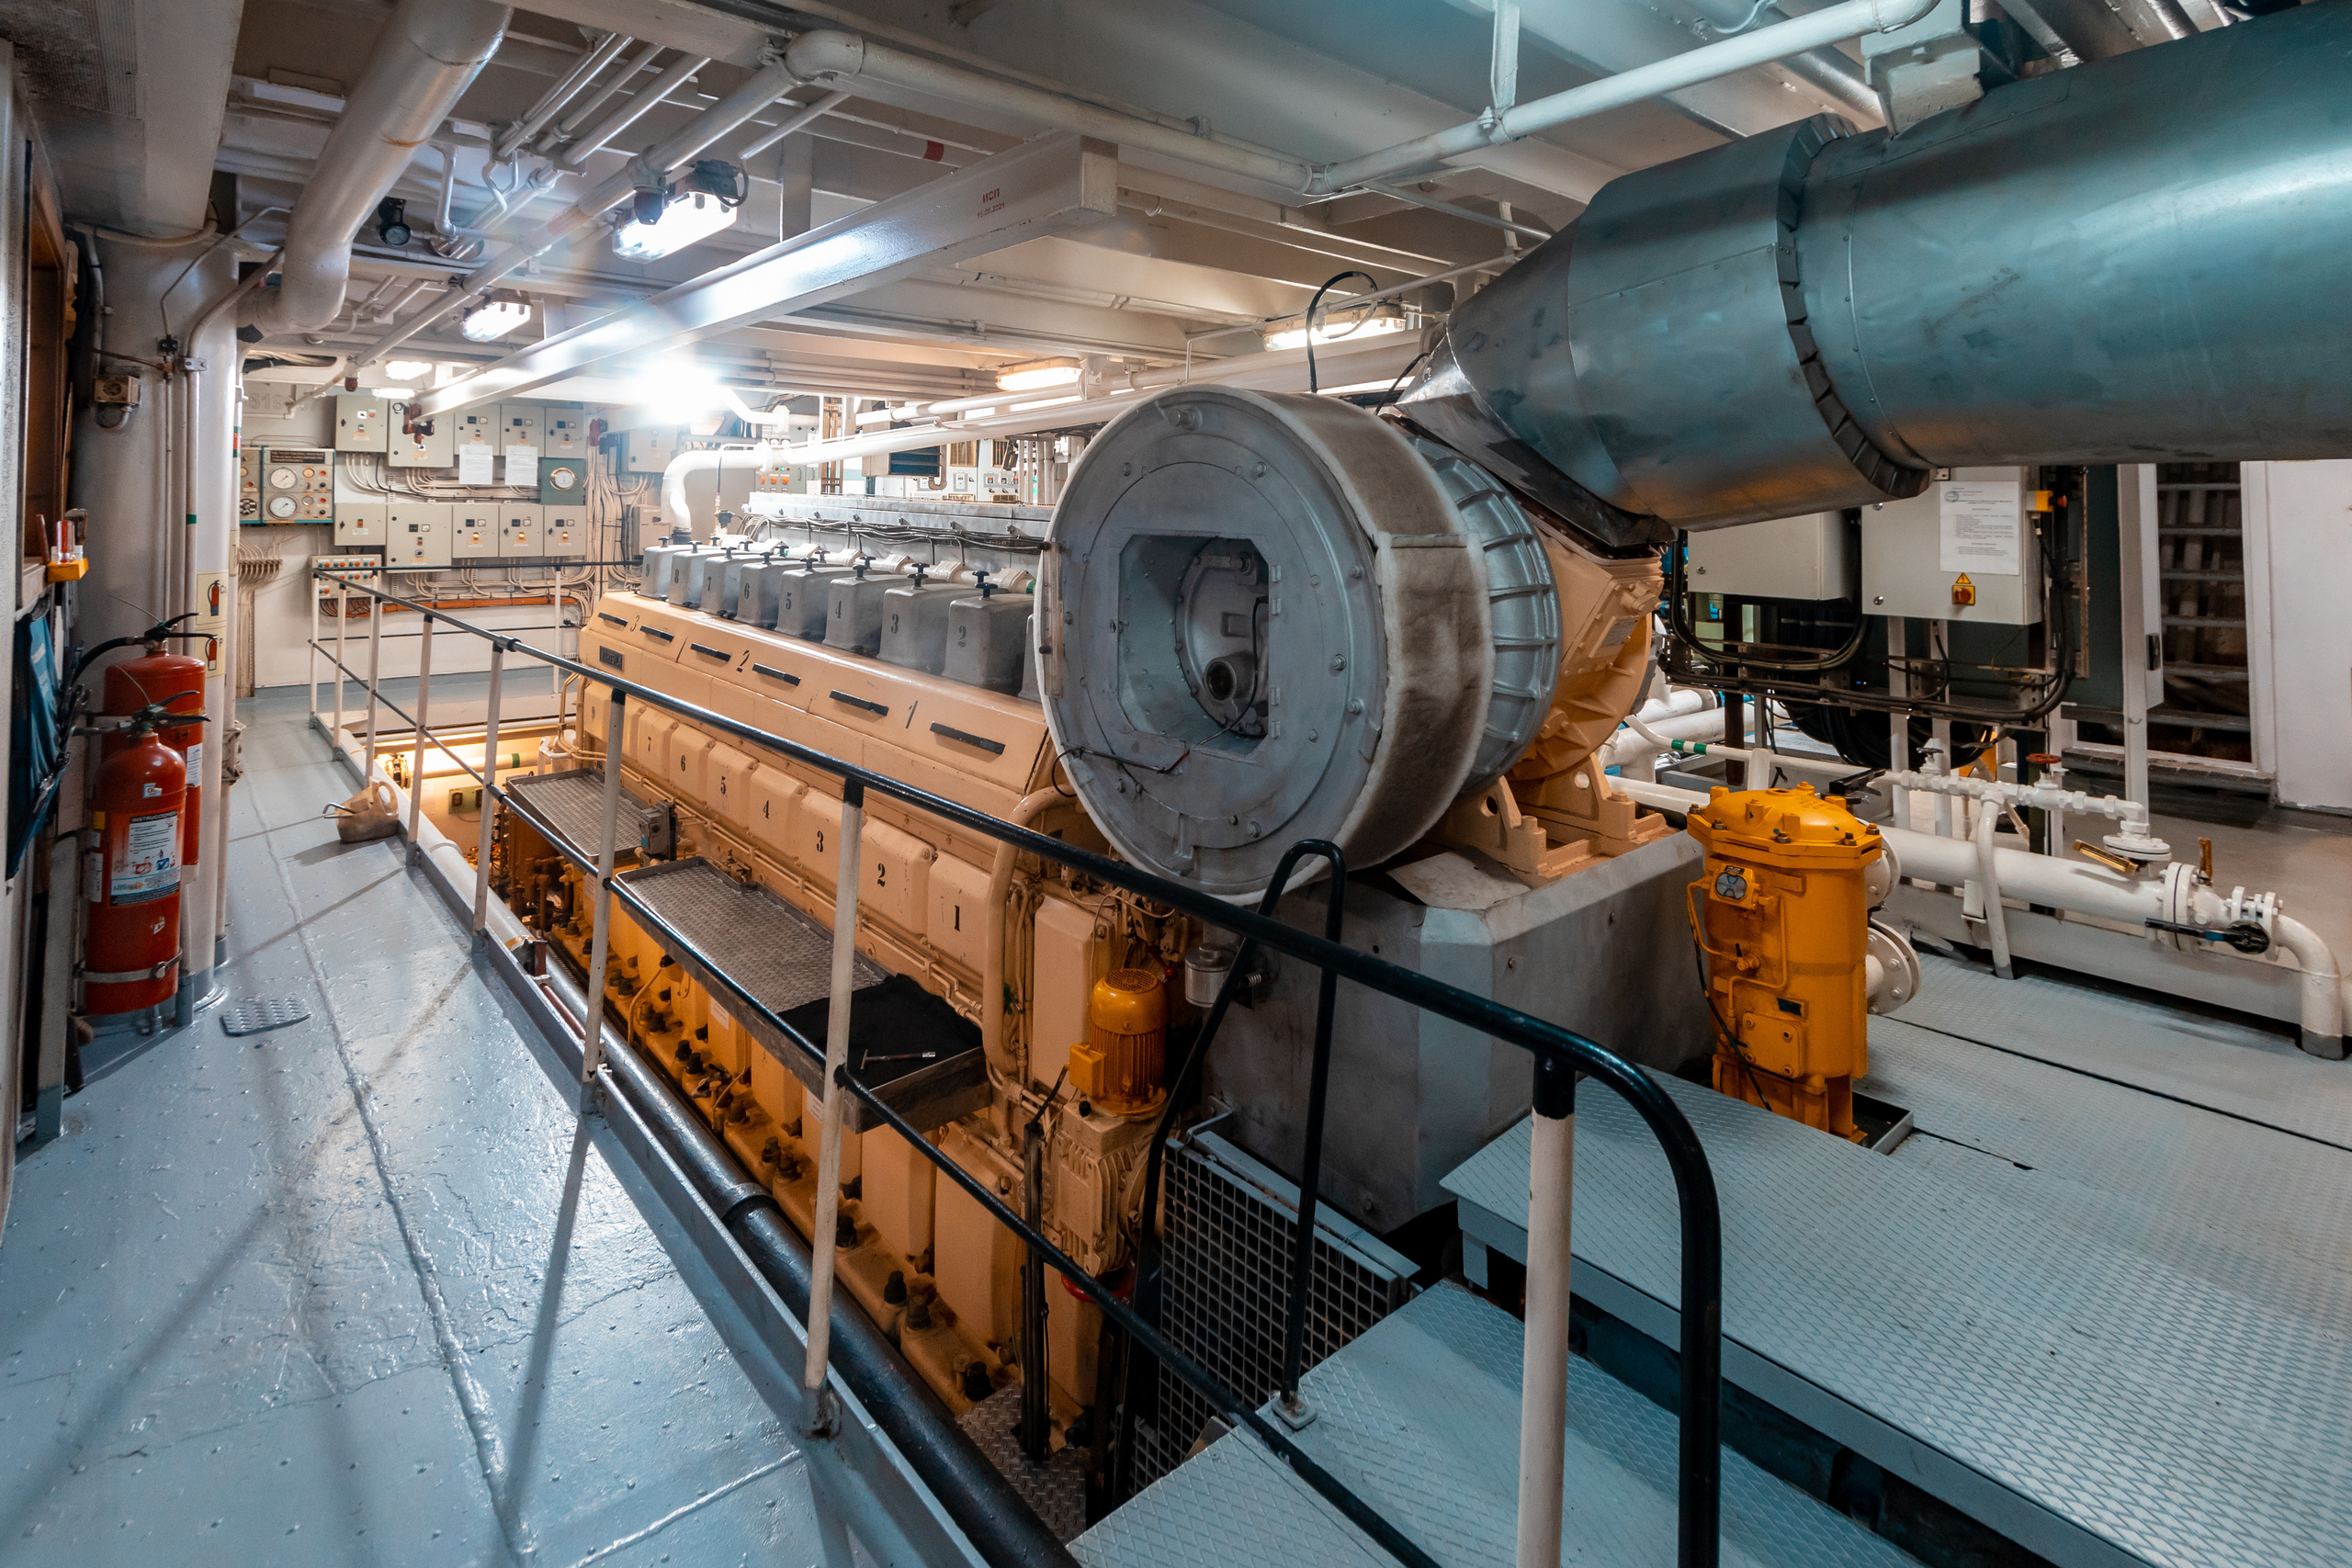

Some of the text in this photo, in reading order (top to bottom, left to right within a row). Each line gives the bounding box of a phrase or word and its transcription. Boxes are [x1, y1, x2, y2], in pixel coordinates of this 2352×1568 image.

[645, 563, 650, 577] 9
[673, 569, 680, 584] 8
[707, 576, 712, 592] 7
[743, 582, 751, 599] 6
[786, 592, 792, 610] 5
[834, 600, 842, 619] 4
[630, 615, 640, 632] 3
[891, 614, 899, 634] 3
[957, 626, 967, 649] 2
[591, 705, 595, 720] 9
[906, 700, 918, 729] 1
[648, 736, 651, 751] 7
[680, 754, 686, 772] 6
[720, 775, 727, 795] 5
[763, 800, 770, 818] 4
[816, 830, 824, 852] 3
[877, 863, 886, 887] 2
[954, 905, 961, 932] 1
